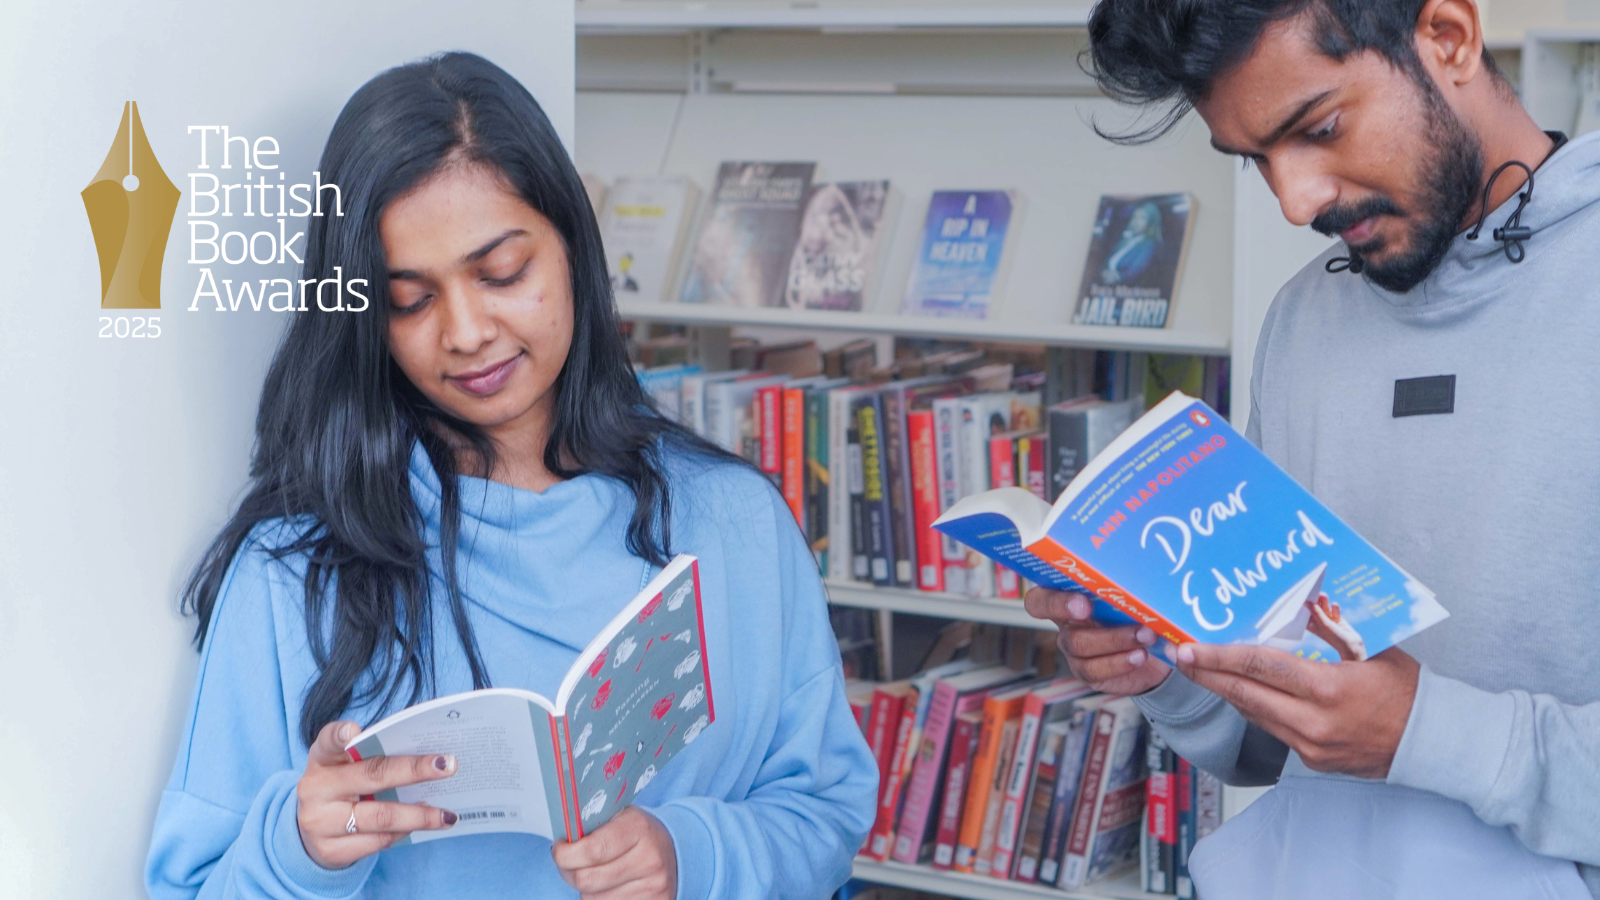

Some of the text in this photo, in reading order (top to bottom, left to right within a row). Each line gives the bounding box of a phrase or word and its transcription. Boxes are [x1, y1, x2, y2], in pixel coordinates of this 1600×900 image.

[963, 194, 977, 216] A
[941, 217, 990, 238] RIP IN
[929, 241, 988, 262] HEAVEN
[1072, 296, 1168, 328] JAIL BIRD
[1091, 434, 1226, 549] ANN NAPOLITANO
[1140, 481, 1248, 576] Dear
[1181, 510, 1334, 631] Edward
[1051, 556, 1097, 584] Dear
[1096, 587, 1159, 623] Edward
[615, 677, 650, 716] Passing
[632, 679, 660, 710] LARSEN
